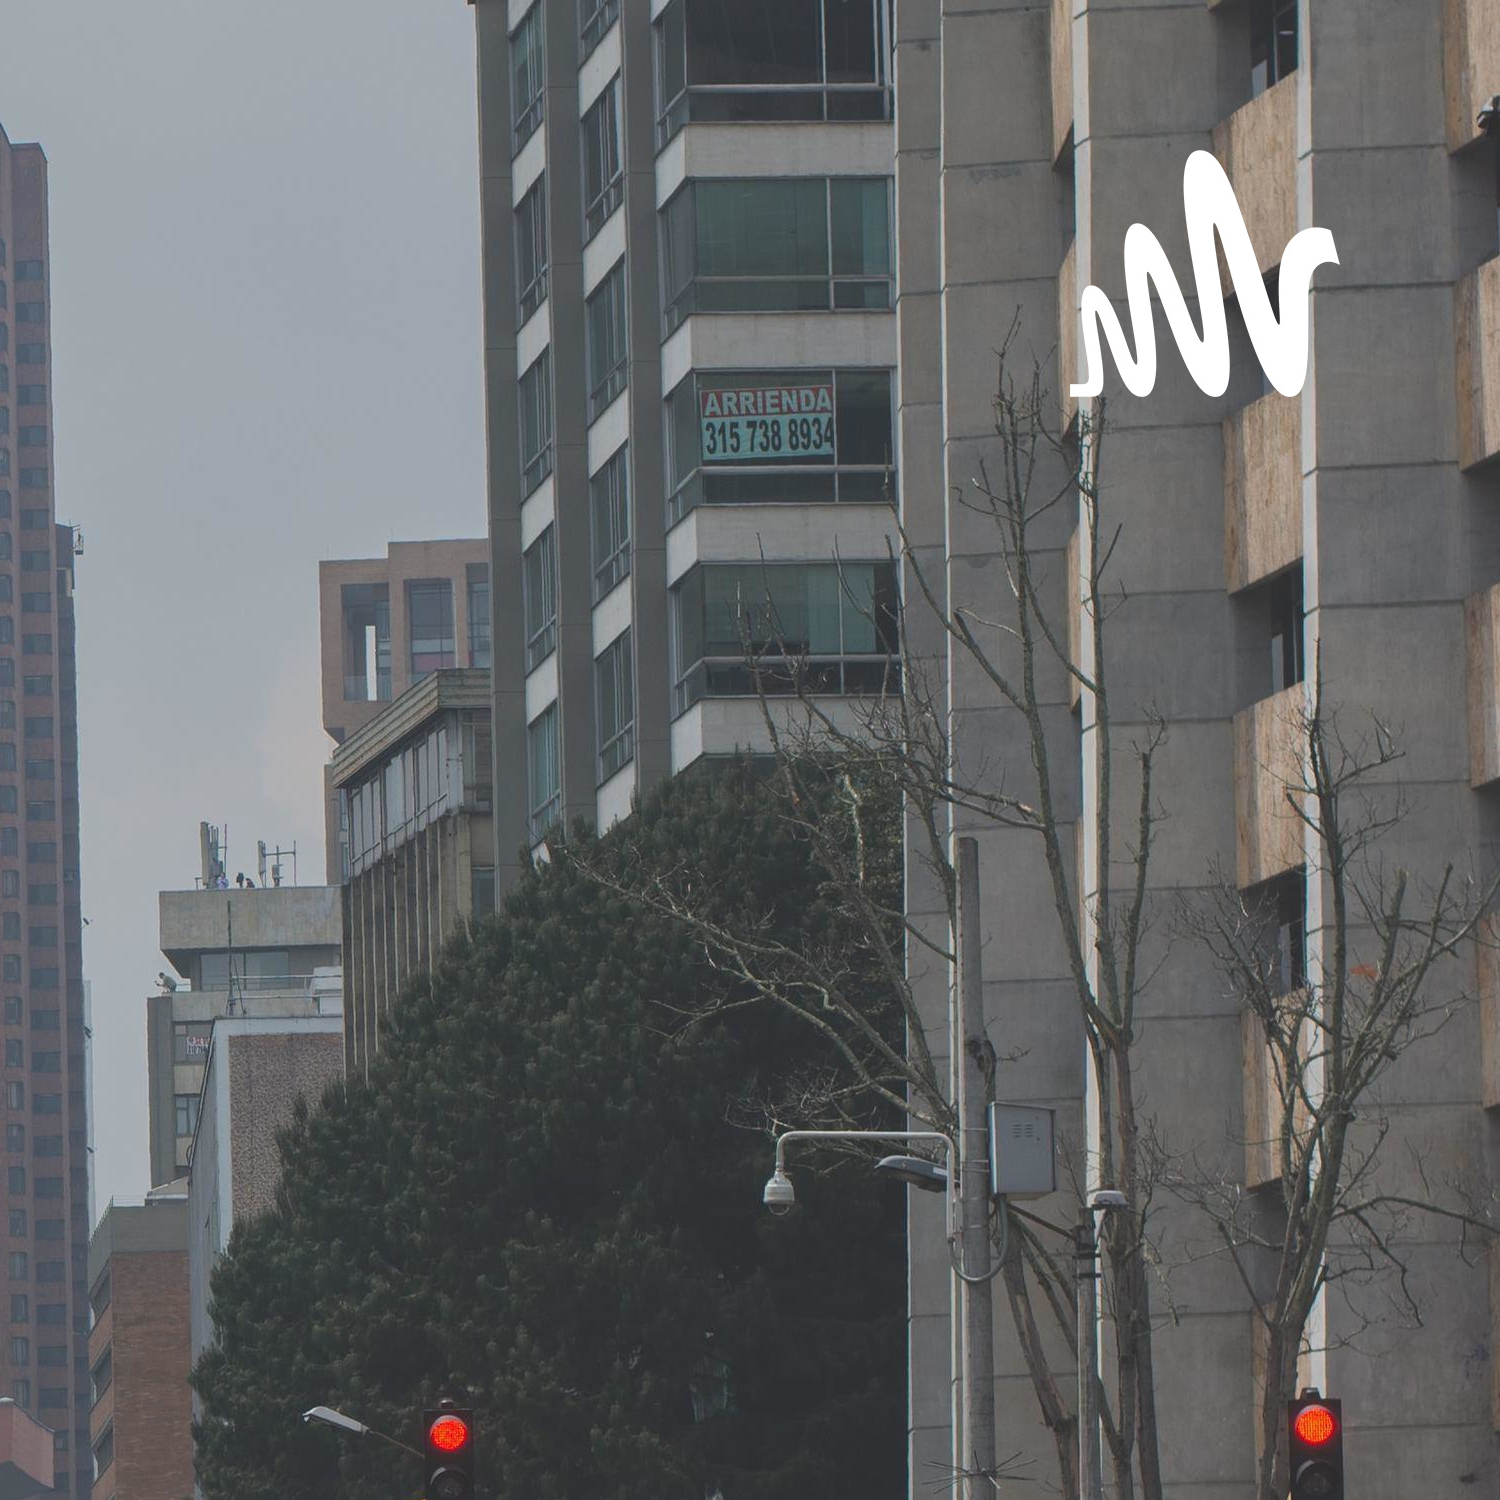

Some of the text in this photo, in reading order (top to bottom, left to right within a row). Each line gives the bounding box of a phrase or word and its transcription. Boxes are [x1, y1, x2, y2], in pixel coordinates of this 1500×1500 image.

[704, 388, 833, 417] ARRIENDA
[705, 417, 835, 454] 315 738 8934
